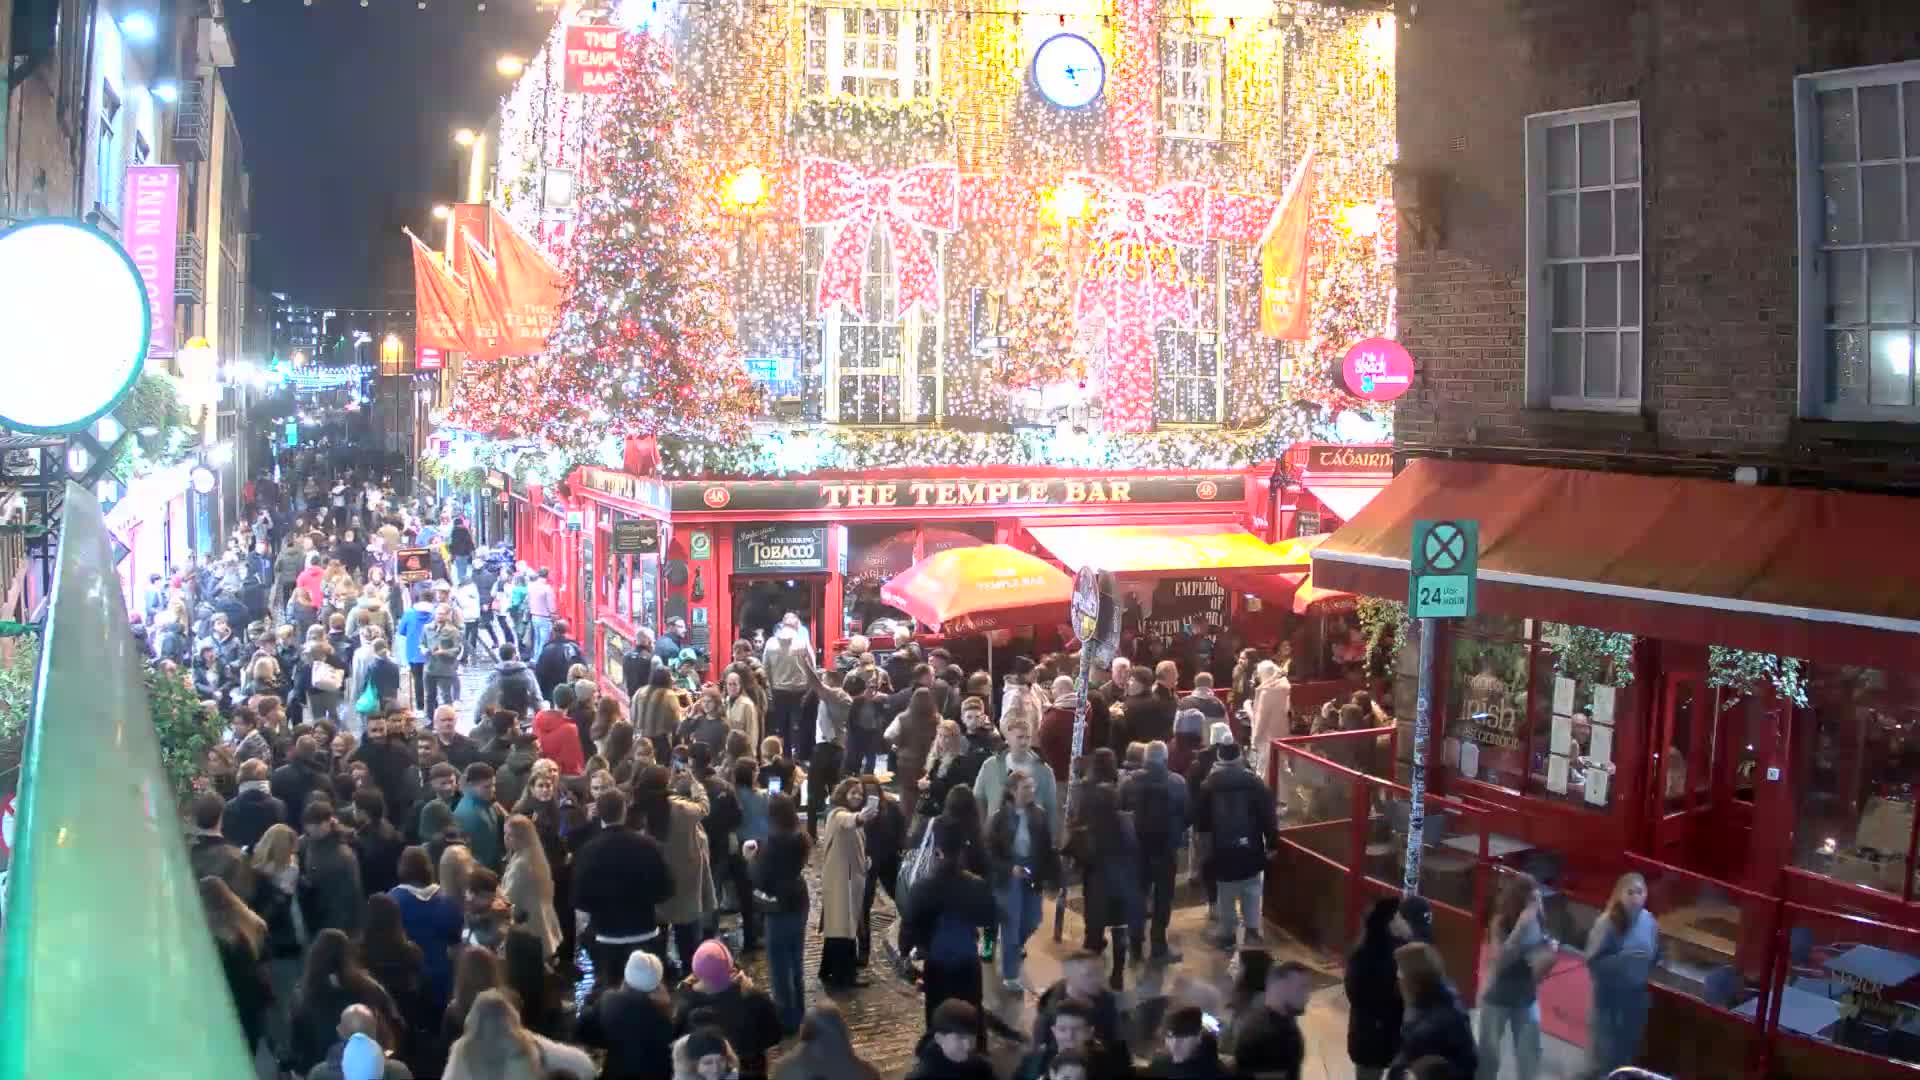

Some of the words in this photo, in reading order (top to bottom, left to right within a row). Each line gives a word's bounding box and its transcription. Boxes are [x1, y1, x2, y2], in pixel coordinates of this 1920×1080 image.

[583, 31, 617, 49] THE
[135, 173, 169, 236] NINE
[820, 484, 897, 506] THE
[910, 481, 1049, 506] TEMPLE
[1064, 480, 1132, 503] BAR
[748, 541, 815, 565] TOBACCO
[1420, 587, 1442, 605] 24
